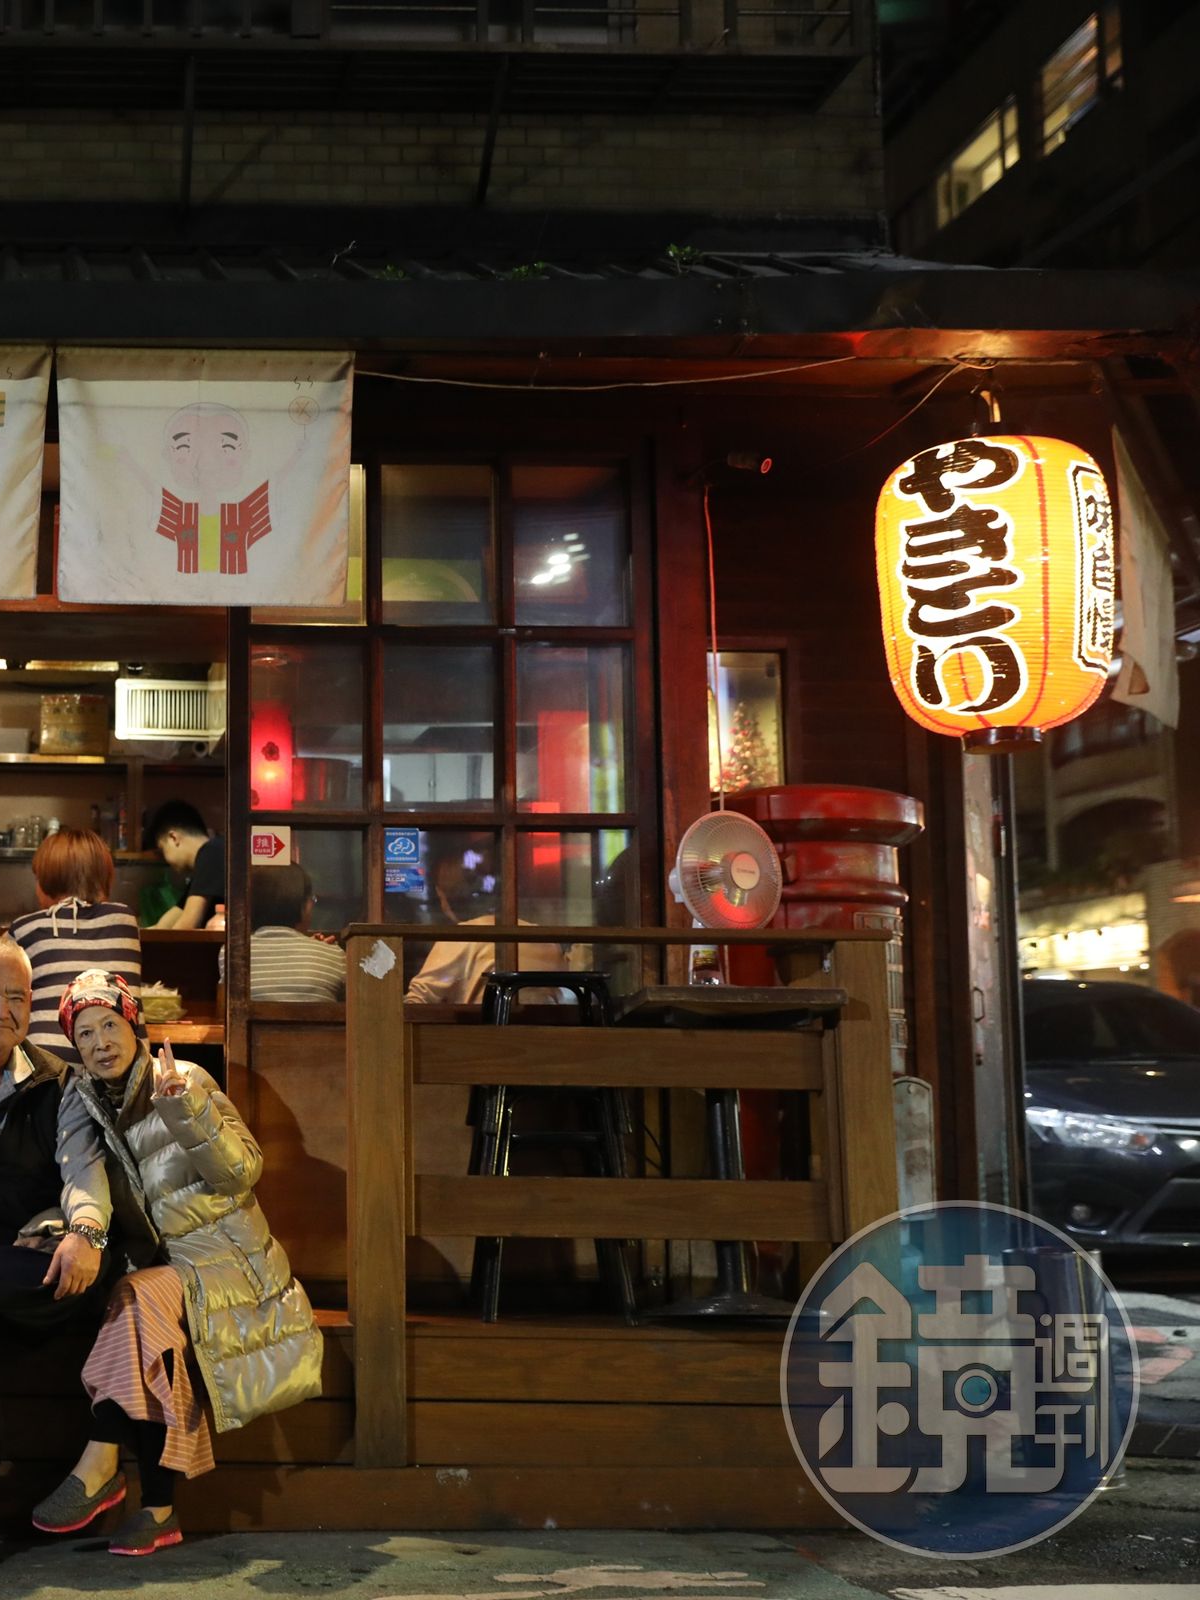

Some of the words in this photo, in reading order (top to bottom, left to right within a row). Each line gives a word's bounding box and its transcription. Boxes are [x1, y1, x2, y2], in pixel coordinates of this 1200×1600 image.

[897, 438, 1024, 714] やきとり
[256, 836, 269, 848] 推
